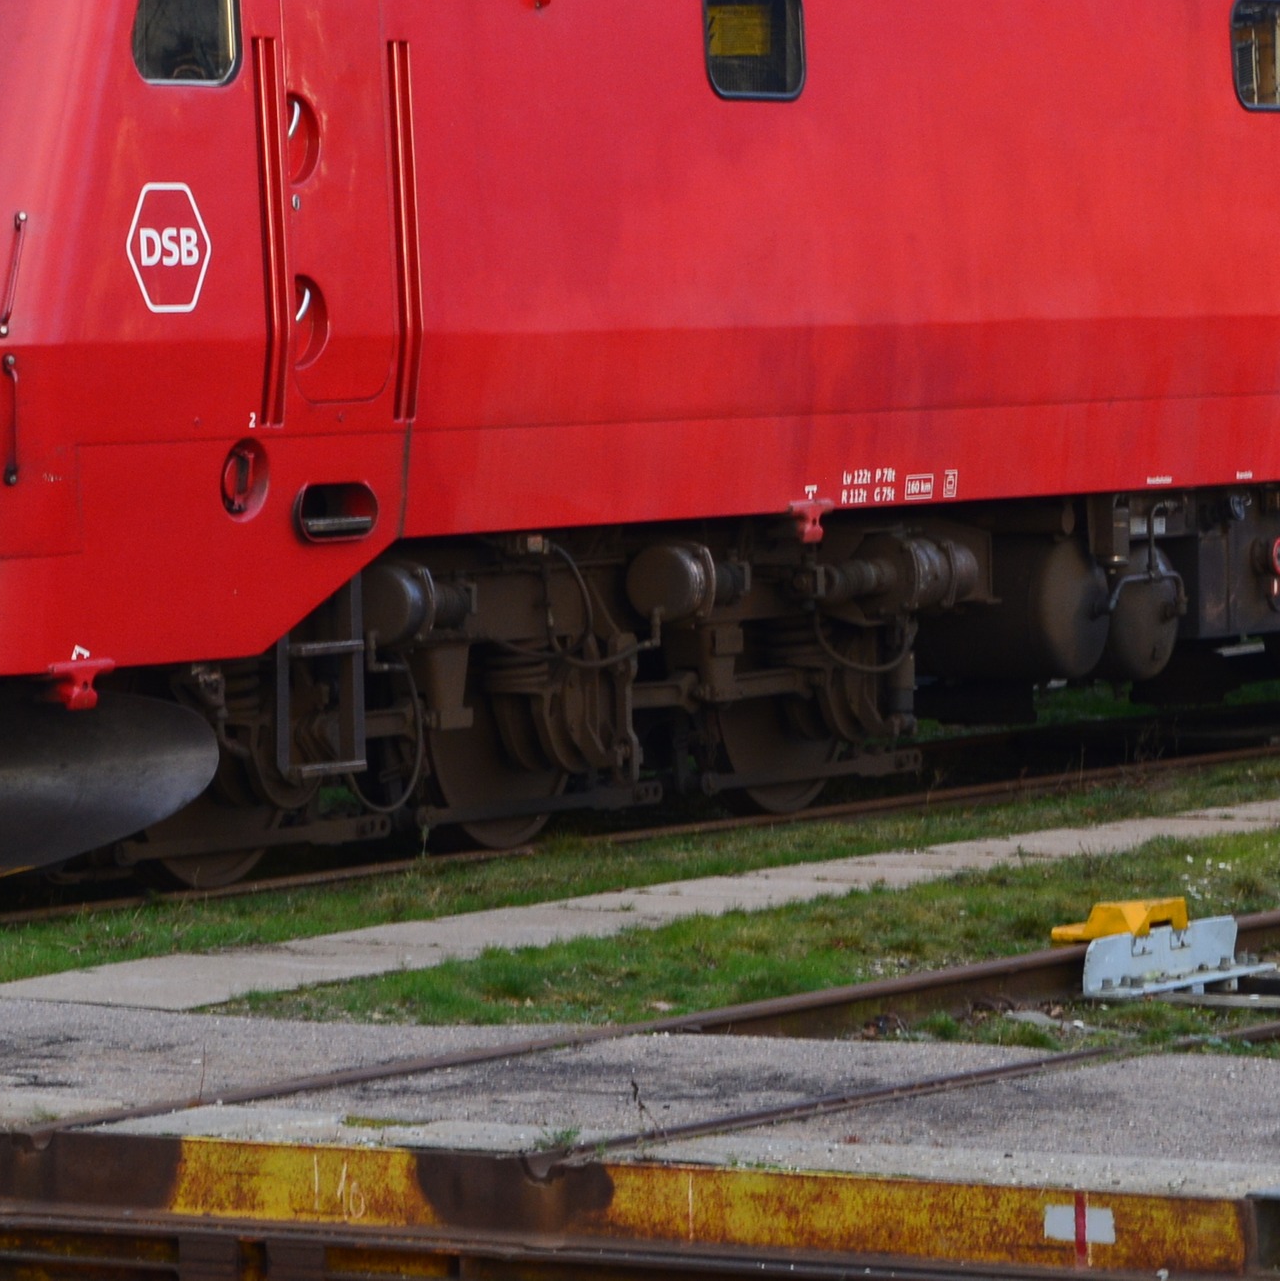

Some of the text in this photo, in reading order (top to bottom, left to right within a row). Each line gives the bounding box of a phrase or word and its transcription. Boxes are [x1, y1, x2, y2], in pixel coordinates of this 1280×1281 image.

[140, 227, 199, 267] DSB
[249, 412, 256, 428] 2
[875, 468, 882, 483] P
[907, 480, 932, 494] 160 km
[841, 488, 848, 505] R
[874, 486, 881, 502] G
